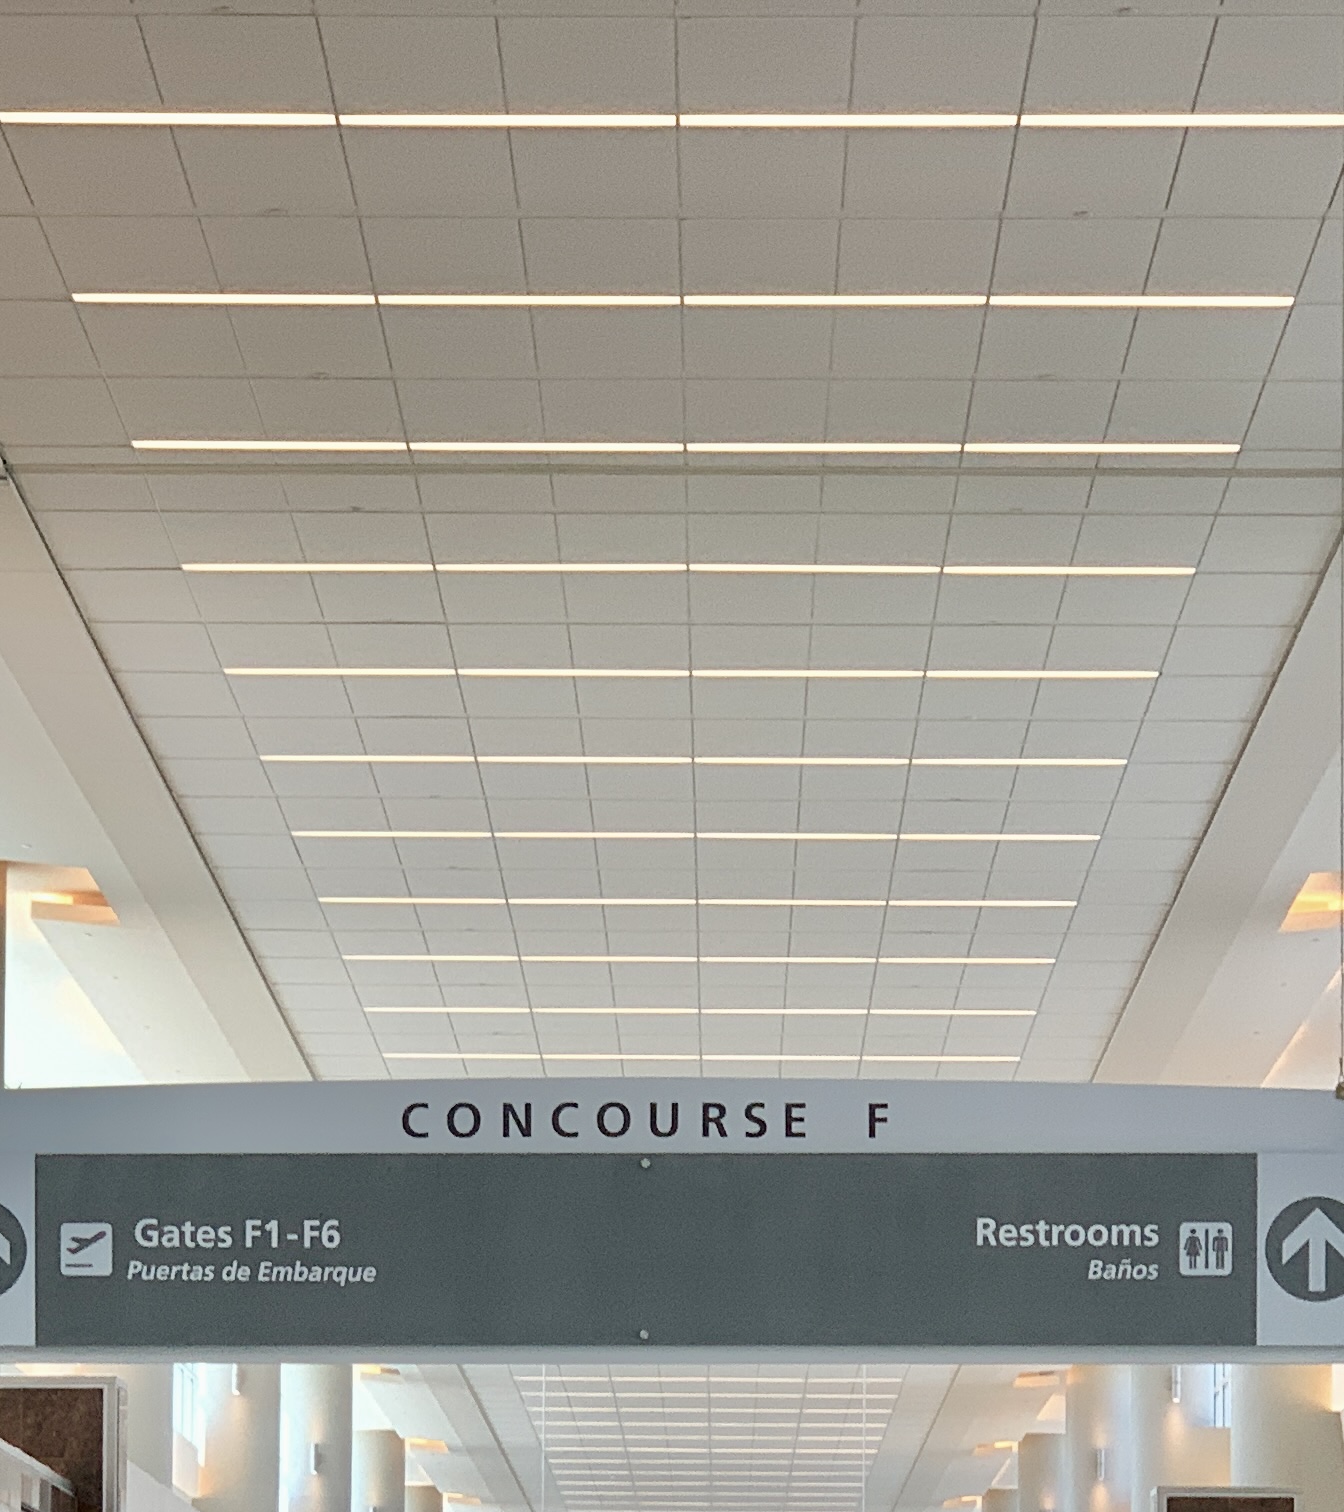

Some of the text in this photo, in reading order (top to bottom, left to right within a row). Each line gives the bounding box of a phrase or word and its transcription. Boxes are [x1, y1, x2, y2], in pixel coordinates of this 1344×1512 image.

[402, 1101, 890, 1139] CONCOURSE F
[134, 1218, 341, 1250] Gates F1-F6
[976, 1217, 1159, 1248] Restrooms
[126, 1261, 377, 1287] Puertas de Embarque
[1087, 1258, 1159, 1281] Baños
